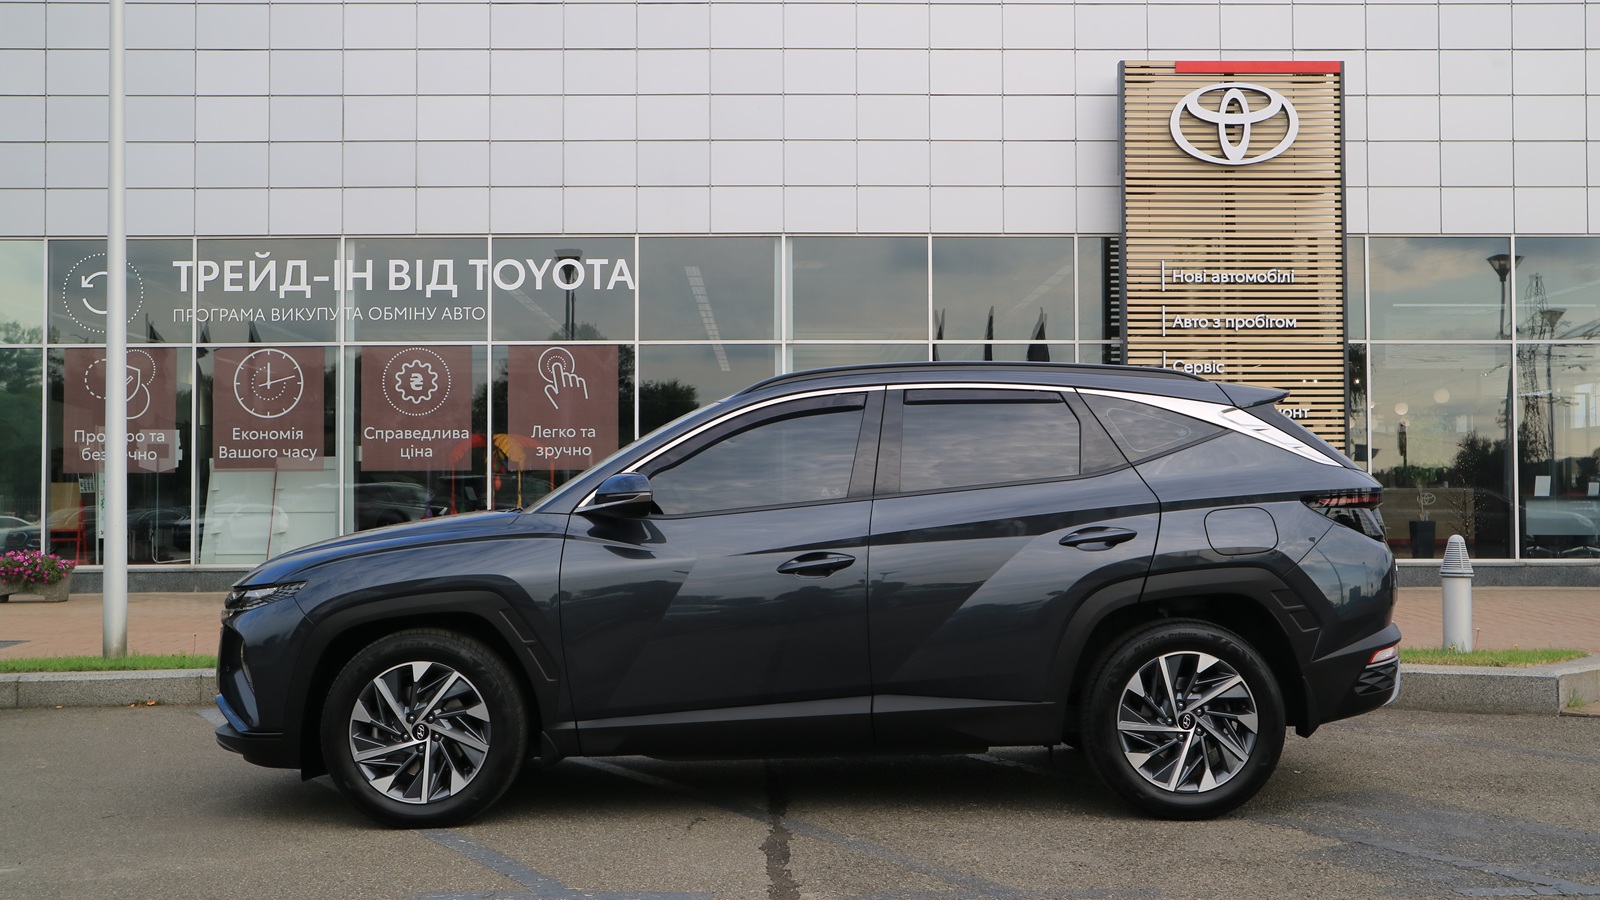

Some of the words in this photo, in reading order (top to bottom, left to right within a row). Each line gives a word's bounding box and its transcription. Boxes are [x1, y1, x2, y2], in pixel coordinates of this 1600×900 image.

[172, 251, 373, 298] ТРЕЙД-ІН
[388, 259, 458, 298] ВІД
[468, 258, 636, 291] TOYOTA
[1172, 269, 1206, 283] Нові
[1211, 269, 1295, 283] автомобілі
[173, 308, 266, 323] ПРОГРАМА
[271, 307, 340, 322] ВИКУПУ
[344, 307, 363, 321] ТА
[368, 306, 437, 321] ОБМІНУ
[441, 306, 486, 321] АВТО
[1172, 315, 1209, 329] Авто
[1213, 318, 1221, 329] з
[1225, 314, 1297, 332] пробігом
[1172, 360, 1225, 375] Сервіс
[74, 429, 145, 446] Проро
[149, 432, 165, 442] та
[232, 427, 304, 440] Економія
[364, 426, 470, 441] Справедлива
[531, 425, 576, 438] Легко
[580, 427, 596, 438] та
[219, 446, 278, 459] Вашого
[282, 448, 318, 461] часу
[400, 445, 433, 458] ціна
[536, 445, 592, 460] зручно
